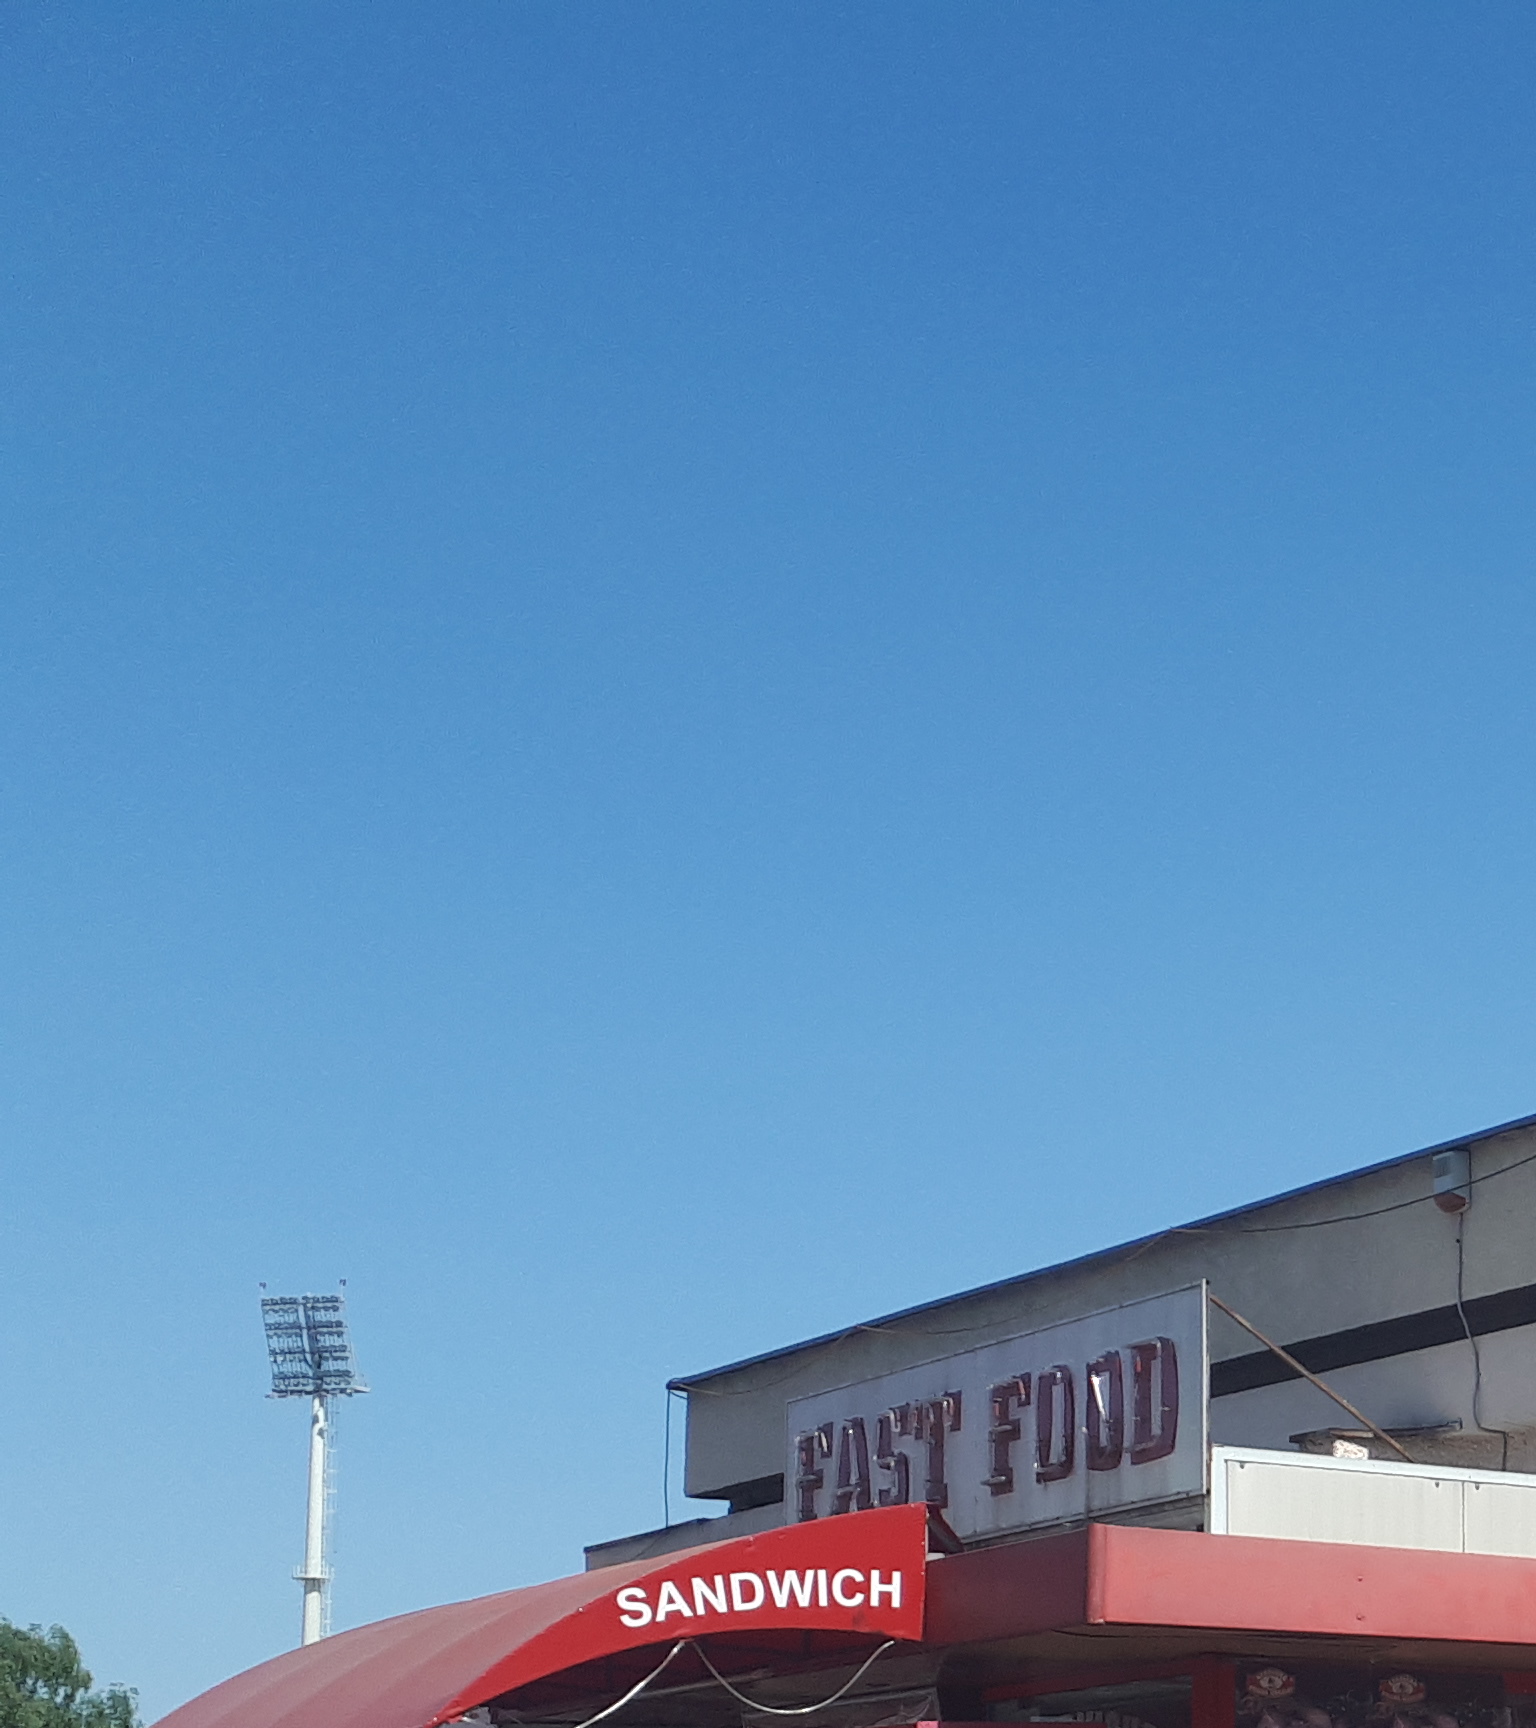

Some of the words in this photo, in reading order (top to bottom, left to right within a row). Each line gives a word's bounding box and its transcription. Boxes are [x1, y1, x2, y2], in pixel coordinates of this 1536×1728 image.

[796, 1390, 962, 1521] FAST
[983, 1335, 1179, 1497] FOOD
[616, 1568, 902, 1629] SANDWICH
